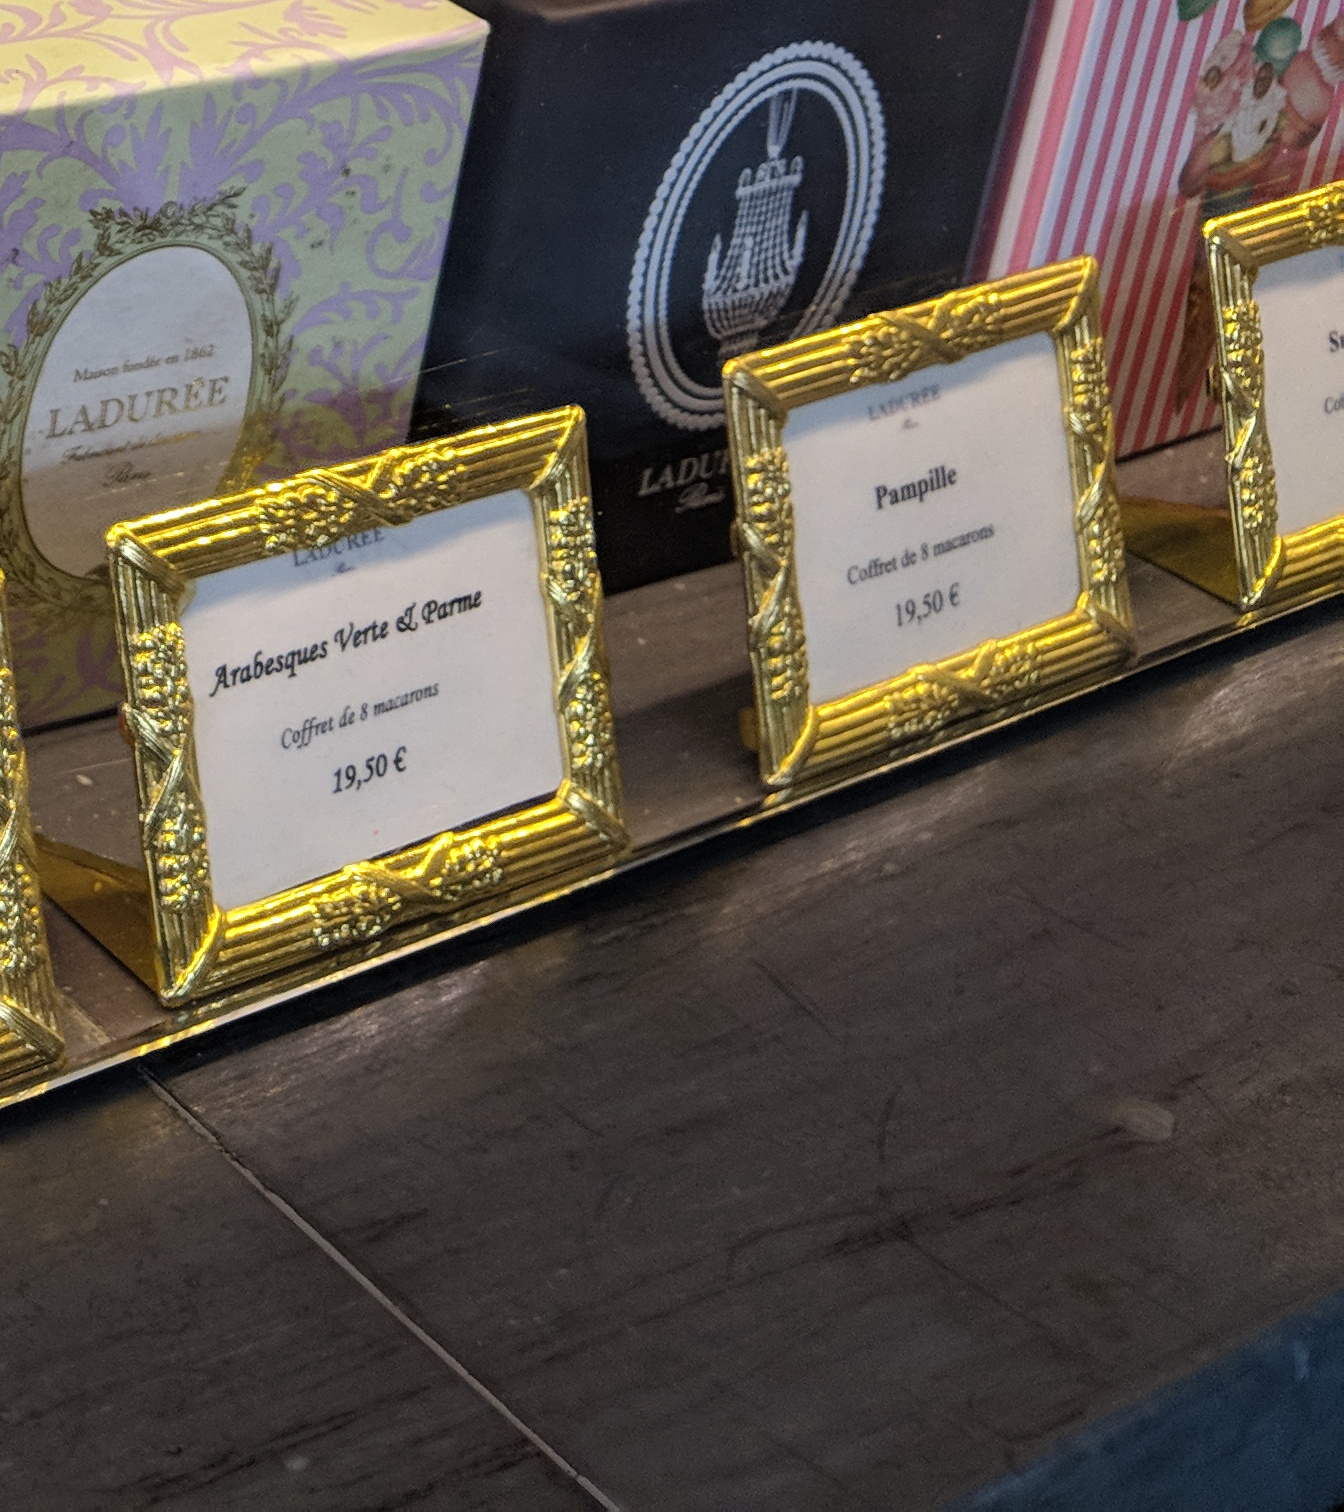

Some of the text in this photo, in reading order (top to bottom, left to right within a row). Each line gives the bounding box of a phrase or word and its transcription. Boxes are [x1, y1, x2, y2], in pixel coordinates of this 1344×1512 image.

[45, 375, 229, 439] LADURÉE
[874, 464, 958, 511] Pampille
[847, 523, 995, 585] Coffret de 8 macarons
[896, 581, 961, 627] 19,50 €
[209, 590, 482, 698] Arabesques Verte & Parme
[281, 683, 440, 750] Coffret de 8 macarons
[332, 745, 407, 793] 19,50 €
